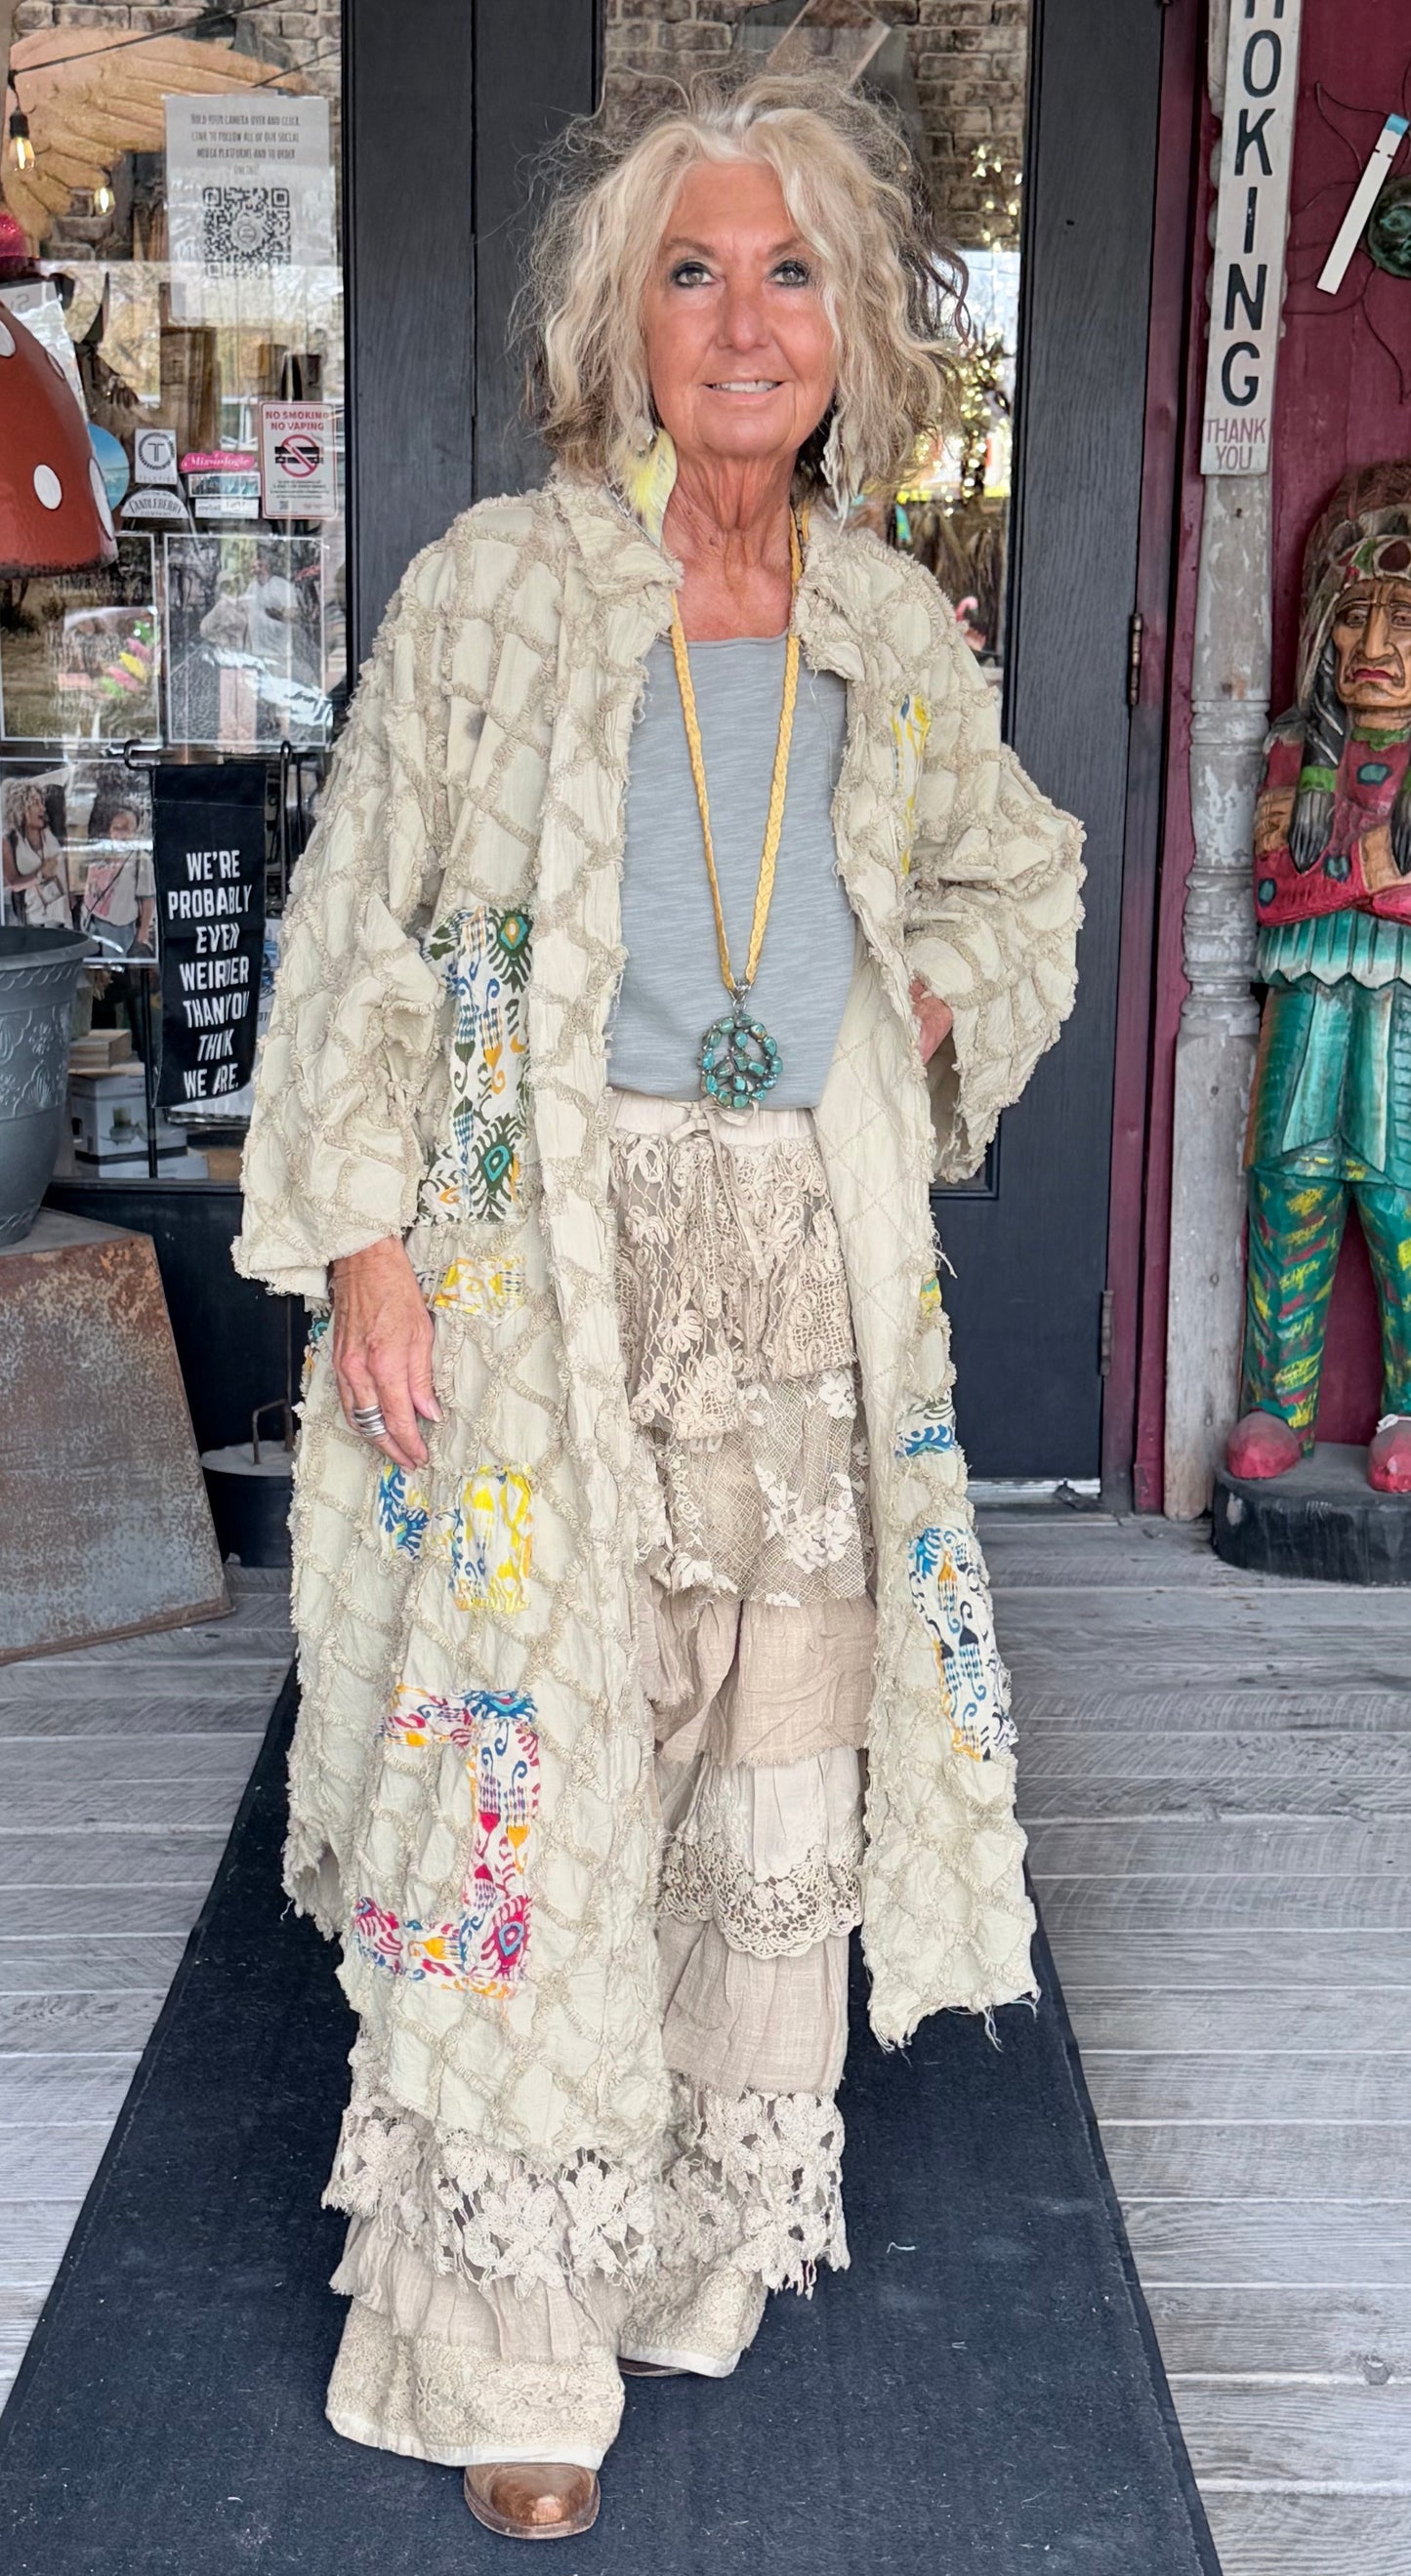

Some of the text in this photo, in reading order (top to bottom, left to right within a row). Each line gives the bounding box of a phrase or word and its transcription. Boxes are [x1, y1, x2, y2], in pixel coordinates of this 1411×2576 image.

[225, 114, 249, 125] CAMERA
[251, 115, 266, 126] OVER
[267, 115, 280, 126] AND
[219, 132, 241, 142] FOLLOW
[277, 133, 299, 143] SOCIAL
[196, 147, 217, 158] MEDIA
[218, 147, 252, 158] PLATFORMS
[254, 148, 267, 159] AND
[276, 148, 296, 160] ORDER
[1222, 0, 1284, 406] OKING
[266, 411, 329, 421] NO SMOKING
[270, 422, 324, 431] NO VAPING
[1206, 418, 1266, 444] THANK
[1216, 445, 1253, 470] YOU
[186, 849, 241, 882] WE'RE
[167, 883, 253, 920] PROBABLY
[195, 921, 240, 955] EVEN
[183, 990, 250, 1029] THAN YOU
[184, 1068, 208, 1100] WE
